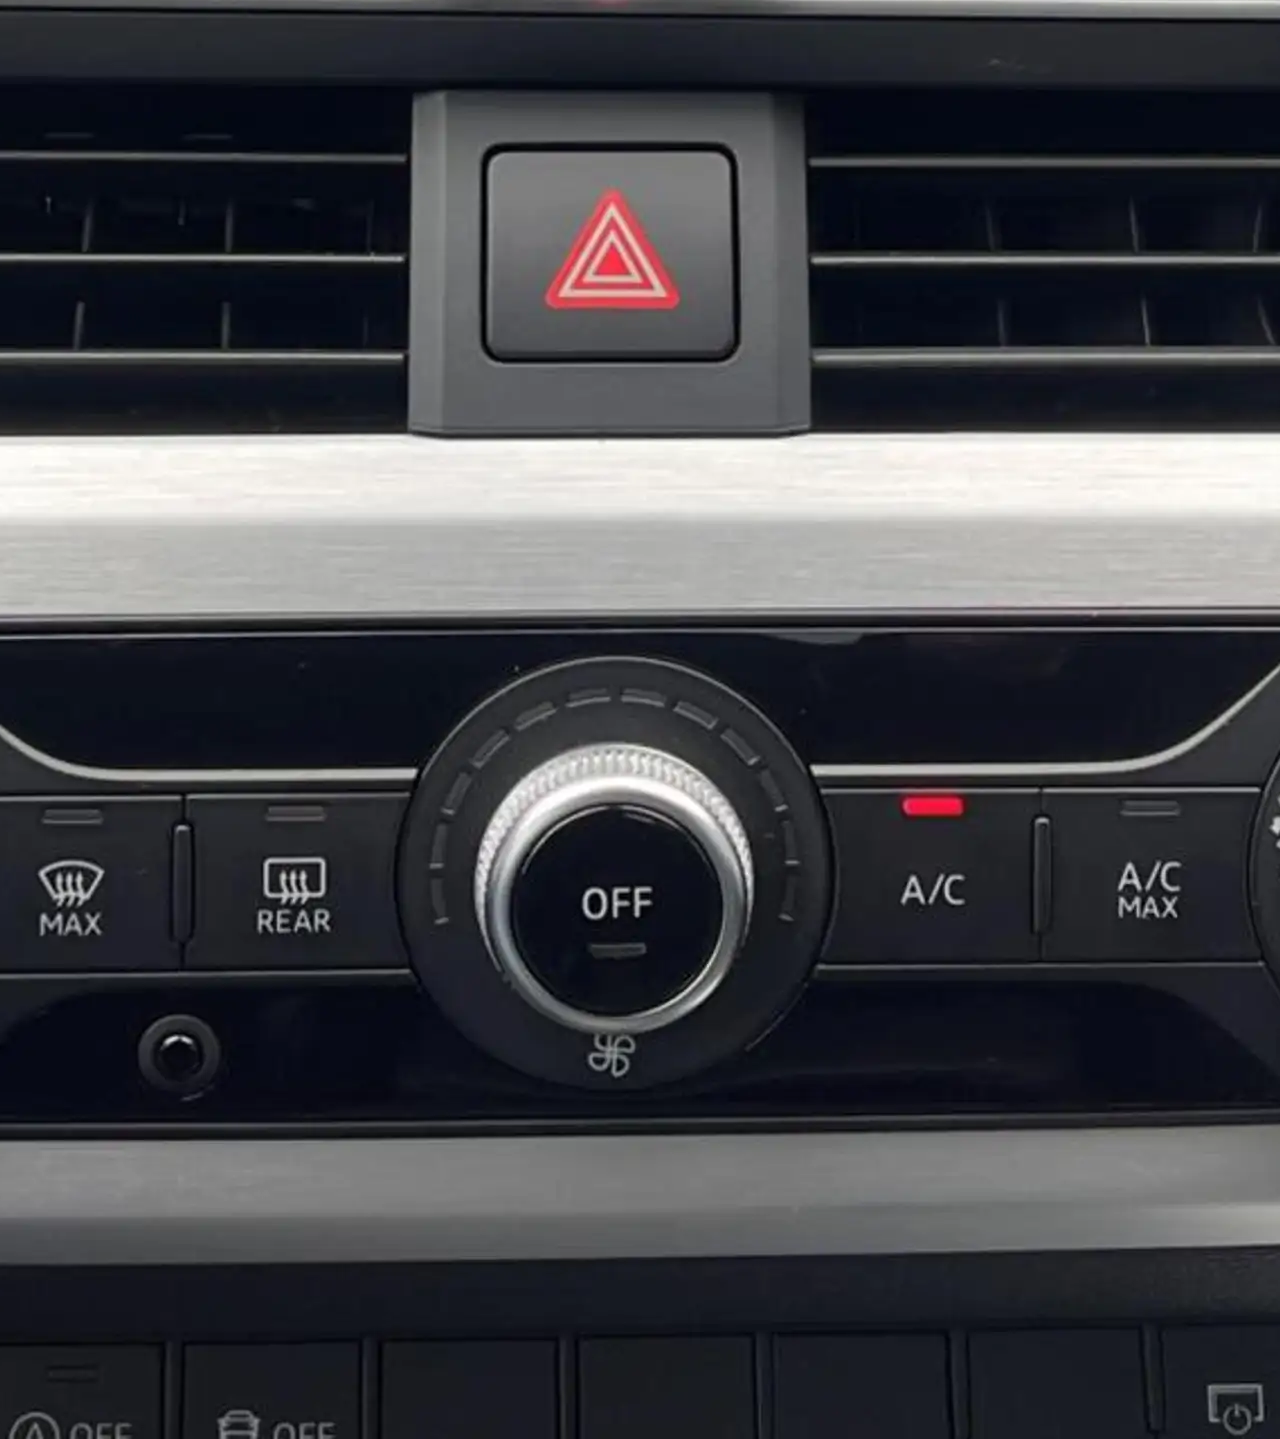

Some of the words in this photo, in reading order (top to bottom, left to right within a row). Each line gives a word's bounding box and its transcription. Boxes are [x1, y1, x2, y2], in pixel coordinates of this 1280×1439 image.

[901, 873, 965, 907] A/C
[1116, 861, 1181, 892] A/C
[581, 886, 653, 920] OFF
[1117, 895, 1180, 918] MAX
[39, 912, 104, 936] MAX
[256, 909, 332, 933] REAR
